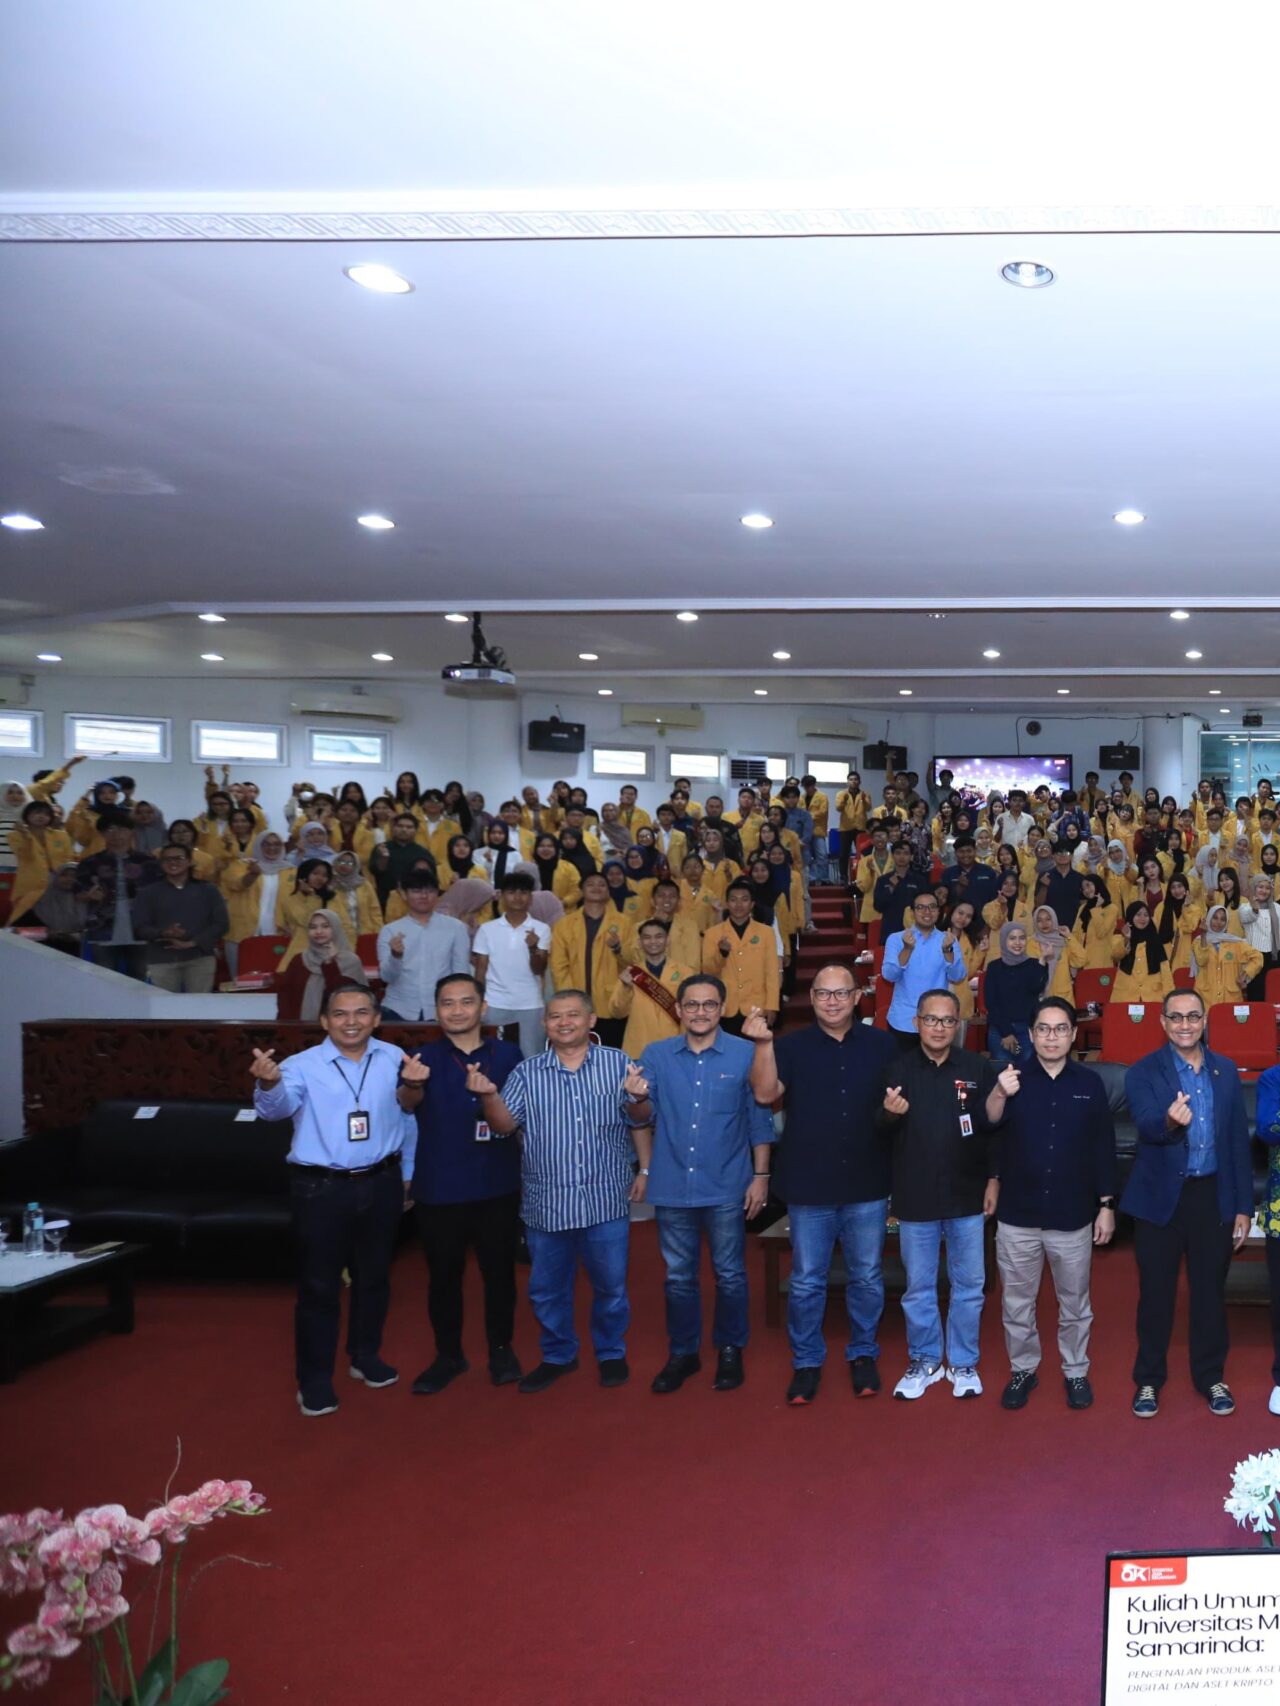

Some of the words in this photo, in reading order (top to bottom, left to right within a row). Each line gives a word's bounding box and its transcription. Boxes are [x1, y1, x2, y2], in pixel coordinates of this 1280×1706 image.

[1127, 1593, 1198, 1613] Kuliah
[1126, 1613, 1253, 1636] Universitas
[1126, 1635, 1265, 1658] Samarinda:
[1127, 1666, 1203, 1679] PENGENALAN
[1206, 1664, 1252, 1675] PRODUK
[1127, 1682, 1170, 1693] DIGITAL
[1174, 1680, 1200, 1690] DAN
[1203, 1679, 1230, 1689] ASET
[1233, 1677, 1273, 1688] KRIPTO
